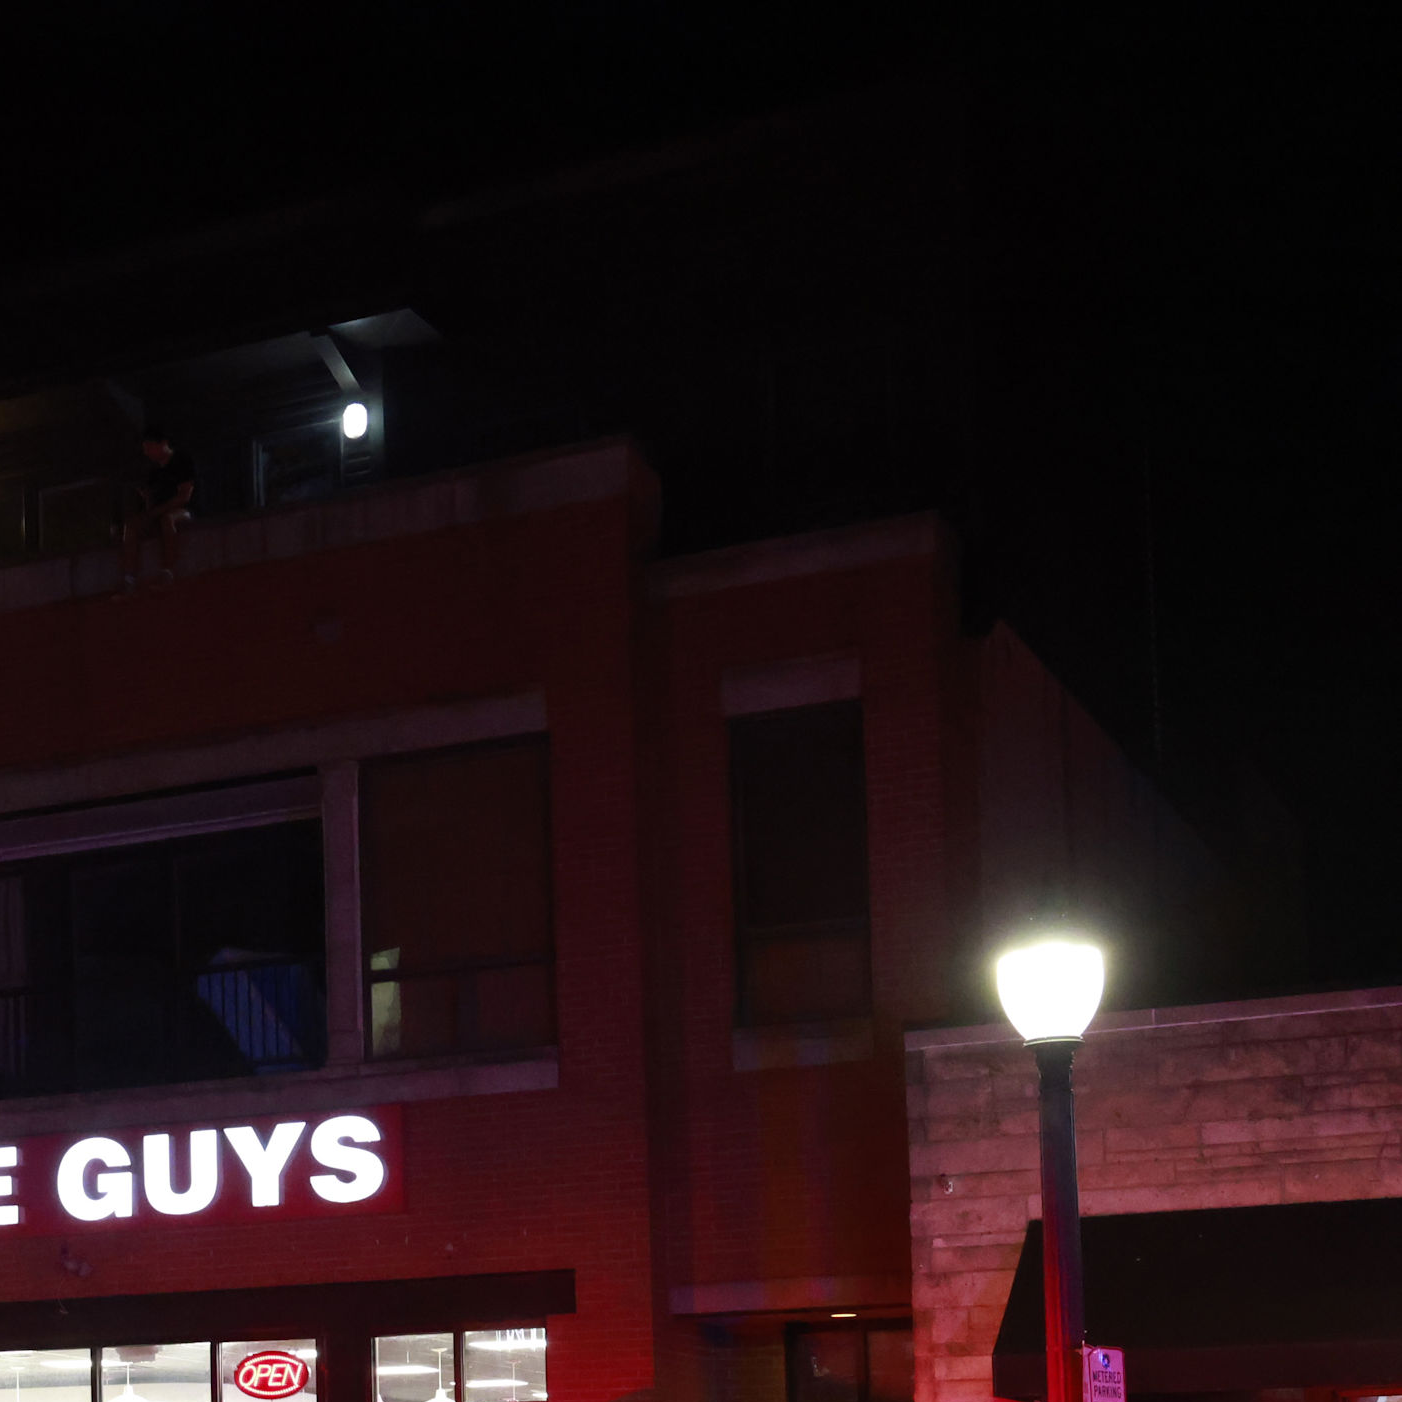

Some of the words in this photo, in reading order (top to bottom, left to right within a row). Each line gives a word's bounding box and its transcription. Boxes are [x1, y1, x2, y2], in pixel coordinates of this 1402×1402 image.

[57, 1114, 385, 1222] GUYS
[239, 1363, 302, 1387] OPEN
[1092, 1370, 1122, 1384] METERED
[1093, 1385, 1122, 1398] PARKING
